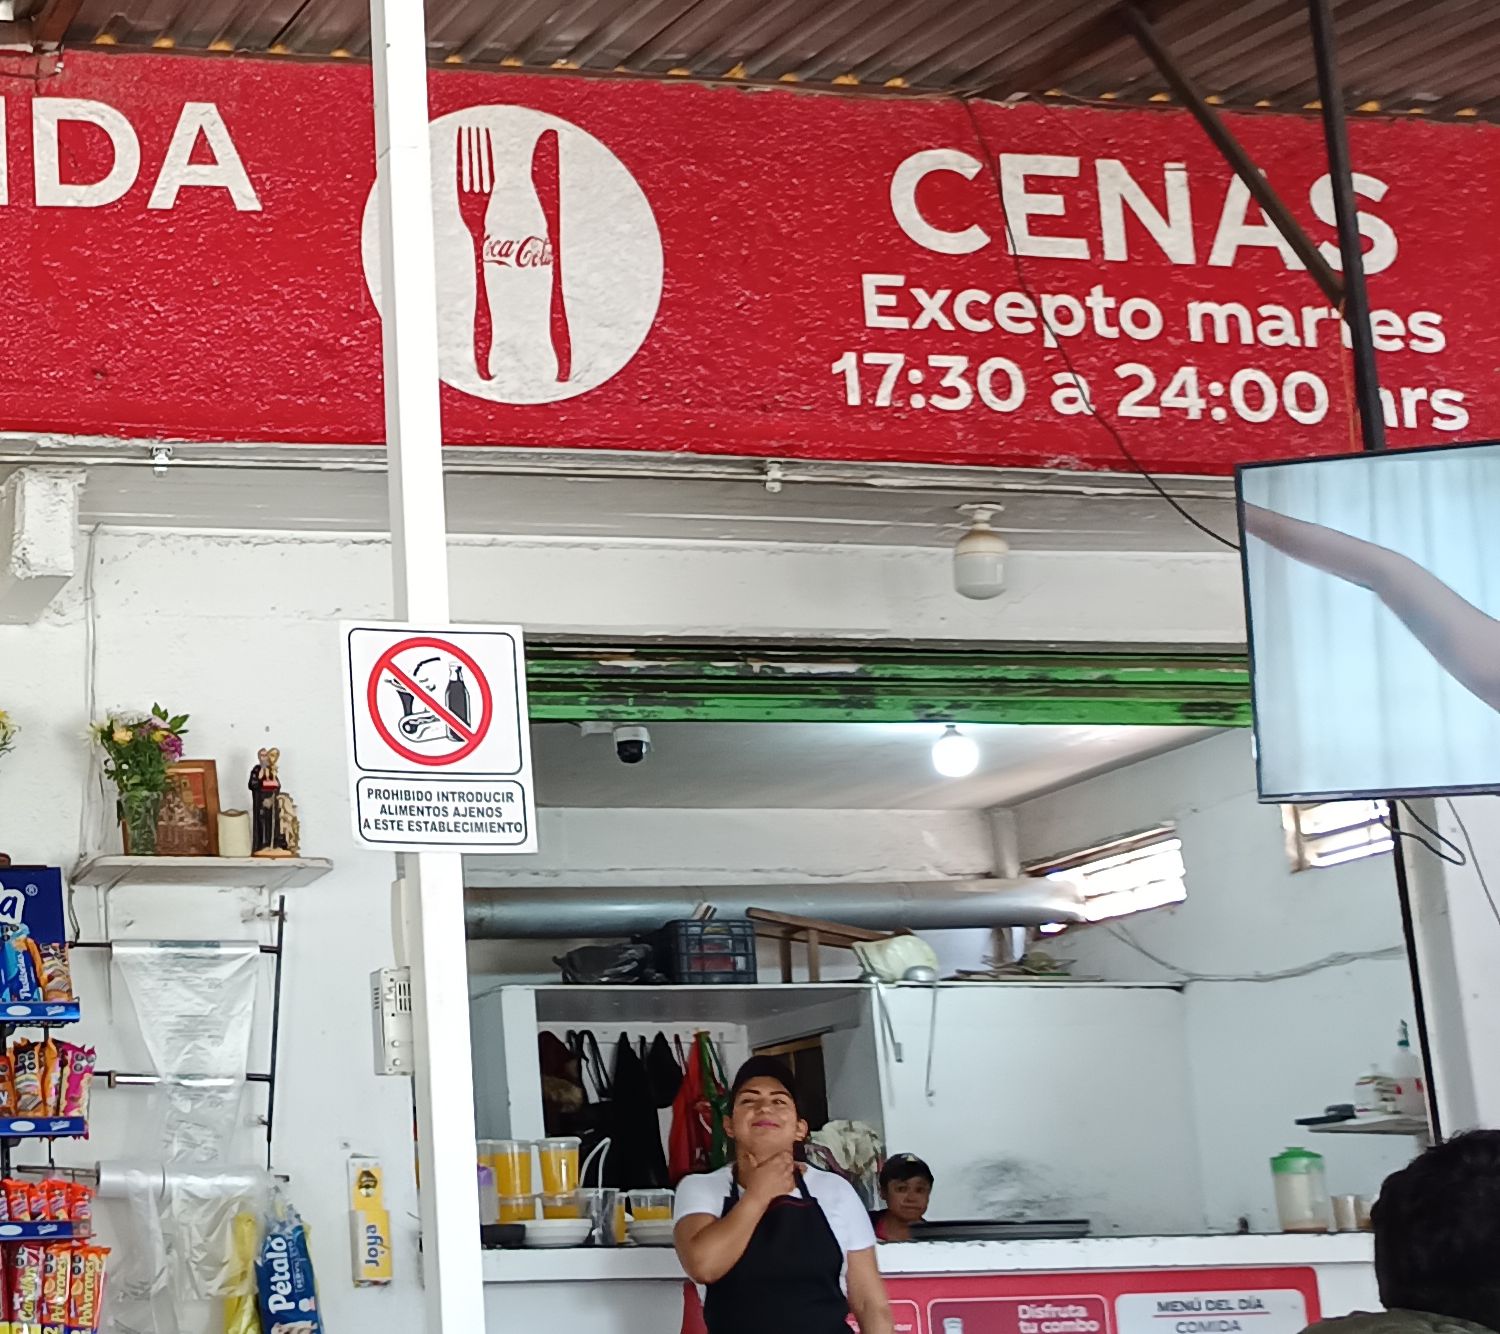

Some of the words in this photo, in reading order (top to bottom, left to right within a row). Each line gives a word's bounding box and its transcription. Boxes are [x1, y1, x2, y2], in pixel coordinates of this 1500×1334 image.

[889, 147, 1399, 275] CENAS
[861, 272, 1164, 342] Excepto
[831, 351, 1025, 415] 17:30
[1051, 369, 1095, 417] a
[1117, 365, 1329, 425] 24:00
[367, 788, 433, 802] PROHIBIDO
[436, 790, 515, 803] INTRODUCIR
[380, 804, 449, 817] ALIMENTOS
[453, 806, 503, 818] AJENOS
[363, 818, 371, 830] A
[375, 819, 404, 832] ESTE
[407, 820, 523, 834] ESTABLECIMIENTO
[365, 1225, 385, 1267] Joya
[266, 1236, 296, 1315] Pétalo
[1017, 1304, 1088, 1319] Disfruta
[1156, 1296, 1202, 1312] MENÚ
[1205, 1299, 1236, 1311] DEL
[1238, 1295, 1265, 1310] DÍA
[1018, 1321, 1038, 1334] tu
[1041, 1319, 1100, 1333] combo
[1175, 1320, 1243, 1334] COMIDA
